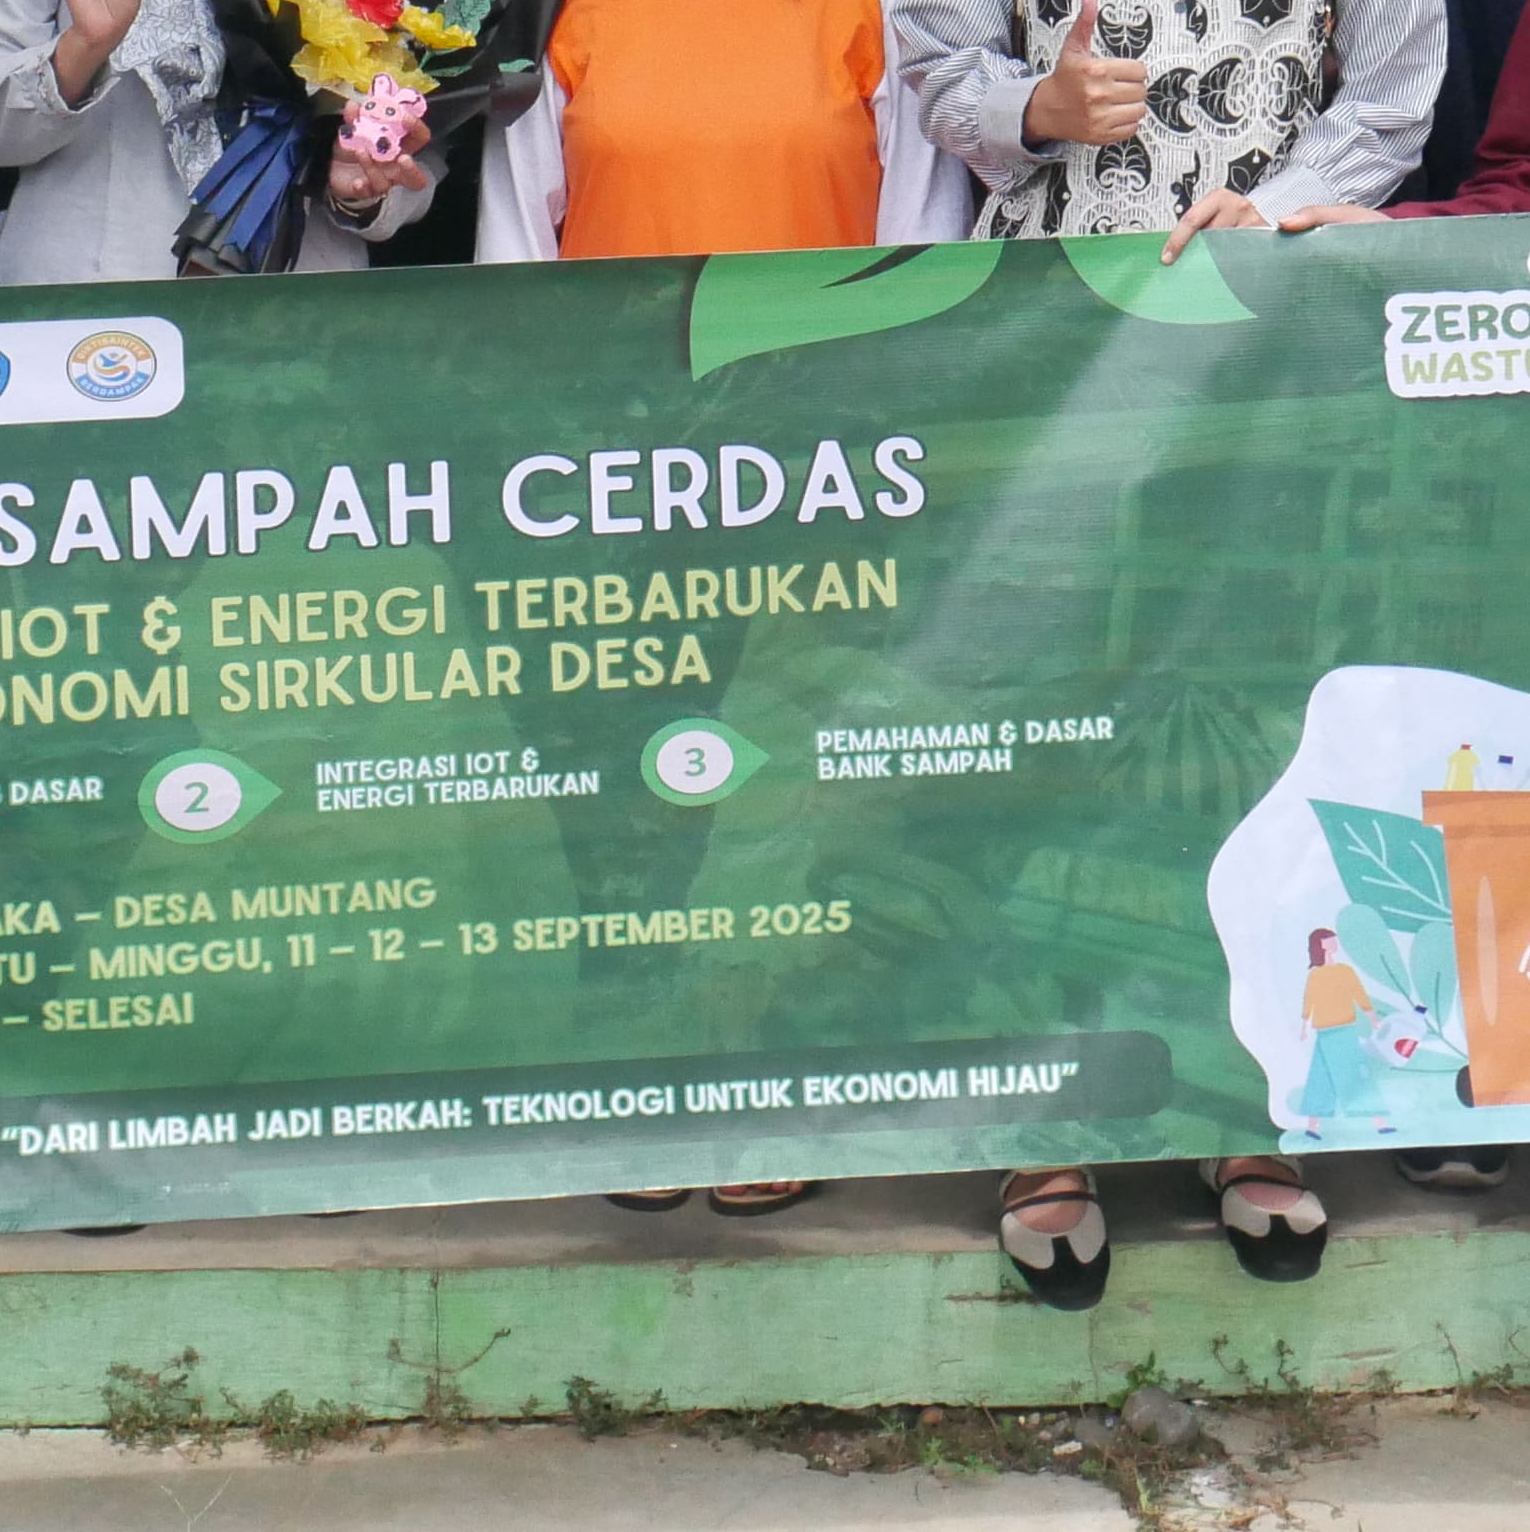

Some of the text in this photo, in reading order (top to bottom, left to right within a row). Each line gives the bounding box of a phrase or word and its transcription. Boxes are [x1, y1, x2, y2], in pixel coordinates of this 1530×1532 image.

[502, 434, 927, 538] CERDAS
[0, 602, 111, 657] IOT
[142, 595, 182, 654] &
[211, 584, 445, 647] ENERGI
[475, 558, 899, 632] TERBARUKAN
[220, 645, 522, 714] SIRKULAR
[550, 634, 712, 693] DESA
[815, 715, 1115, 754] PEMAHAMAN & DASAR
[316, 746, 540, 787] INTEGRASI IOT &
[683, 747, 708, 778] 3
[817, 747, 1013, 782] BANK SAMPAH
[10, 777, 104, 806] DASAR
[184, 781, 210, 814] 2
[316, 770, 600, 813] ENERGI TERBARUKAN
[114, 892, 217, 930] DESA
[231, 877, 437, 923] MUNTANG
[89, 937, 273, 982] MINGGU,
[286, 934, 316, 968] 11
[370, 929, 405, 963] 12
[457, 922, 499, 956] 13
[512, 907, 736, 954] SEPTEMBER
[749, 900, 854, 939] 2025
[41, 993, 194, 1032] SELESAI
[107, 1113, 237, 1152] LIMBAH
[247, 1107, 323, 1143] JADI
[331, 1097, 472, 1137] BERKAH:
[482, 1085, 677, 1129] TEKNOLOGI
[684, 1077, 795, 1115] UNTUK
[802, 1068, 960, 1108] EKONOMI
